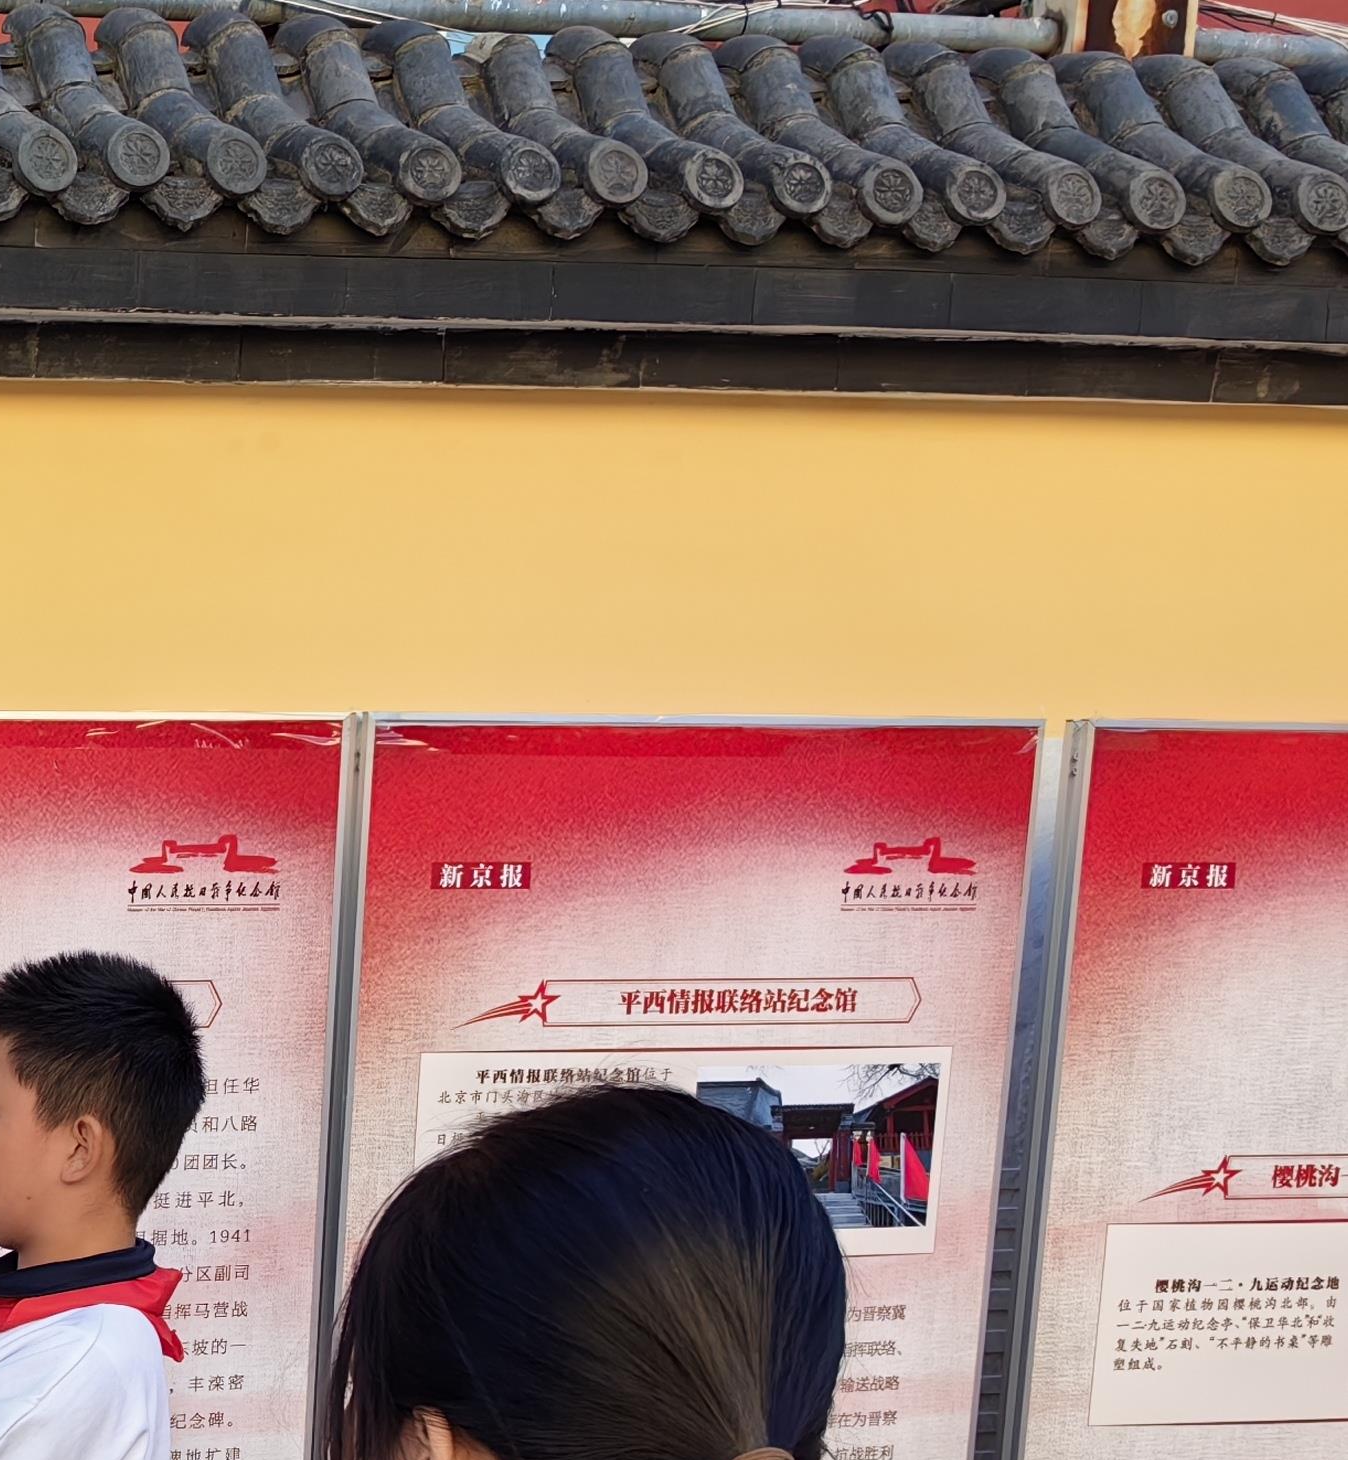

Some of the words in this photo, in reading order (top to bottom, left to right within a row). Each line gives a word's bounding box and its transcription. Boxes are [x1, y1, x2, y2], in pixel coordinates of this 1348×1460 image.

[439, 863, 523, 889] 新京报
[1149, 864, 1228, 888] 新京报
[616, 986, 858, 1016] 平西情报联络站纪念馆
